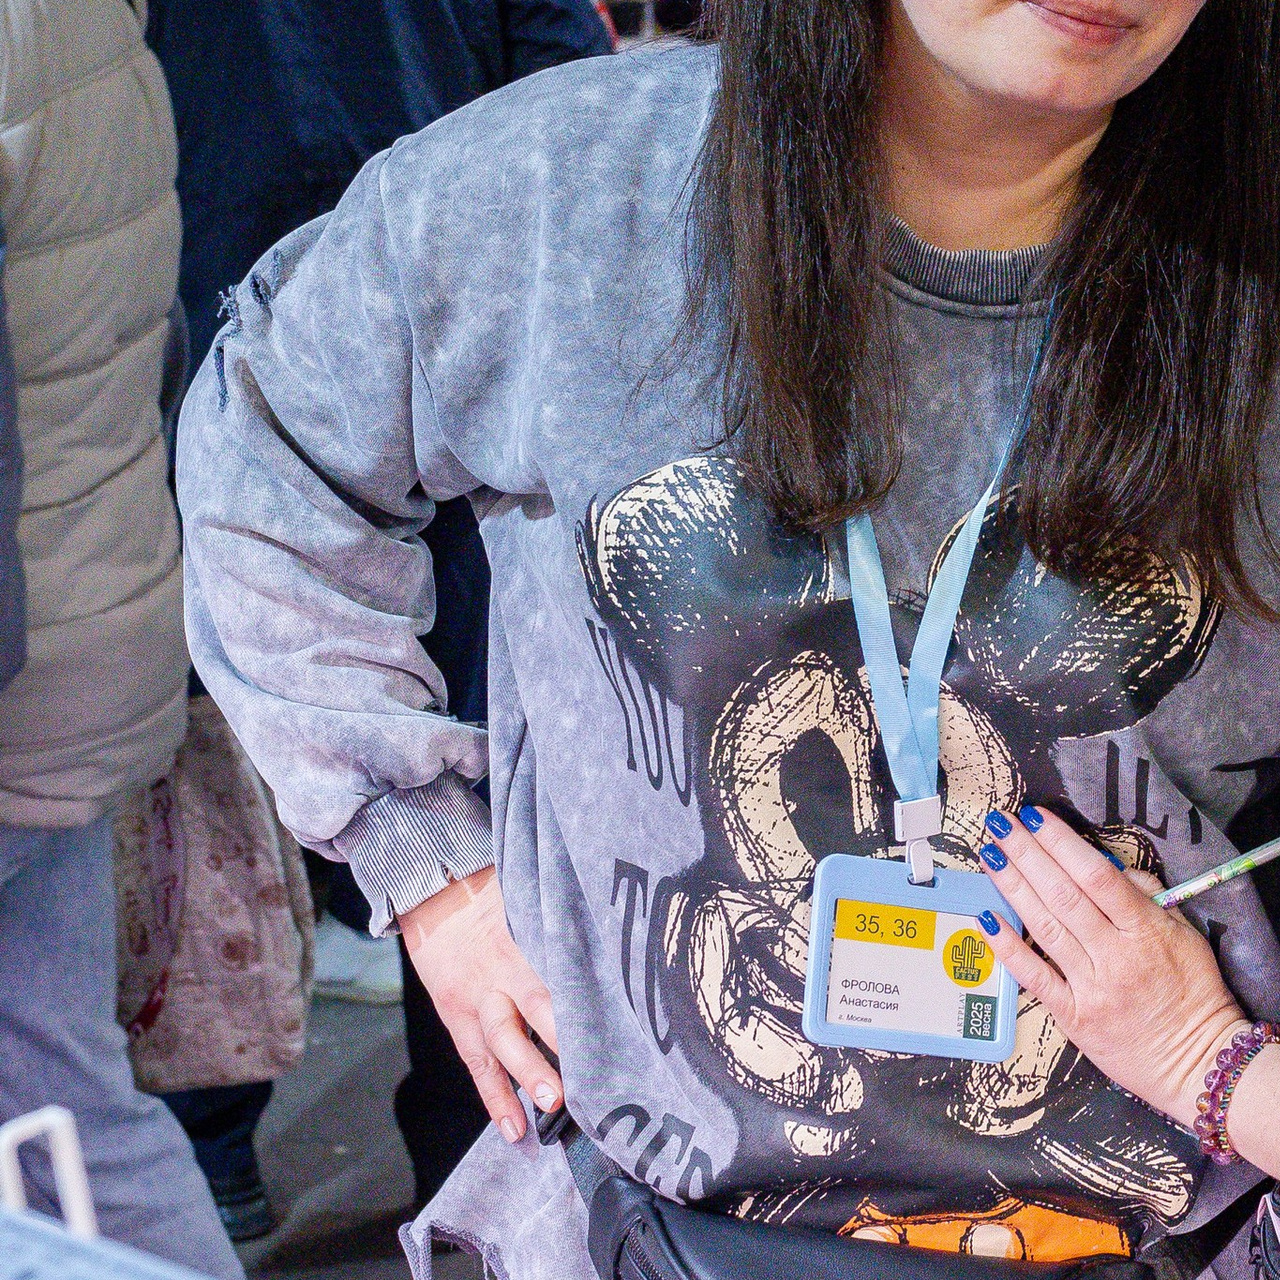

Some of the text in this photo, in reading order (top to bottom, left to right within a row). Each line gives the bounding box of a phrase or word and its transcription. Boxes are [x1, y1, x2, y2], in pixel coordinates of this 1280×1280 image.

[855, 913, 918, 939] 35, 36
[841, 978, 901, 996] ФРОЛОВА
[839, 994, 899, 1012] Анастасия
[957, 992, 965, 1035] ARTPLAY
[846, 1013, 872, 1023] Москва
[969, 1001, 984, 1037] 2025
[982, 1003, 992, 1037] весна
